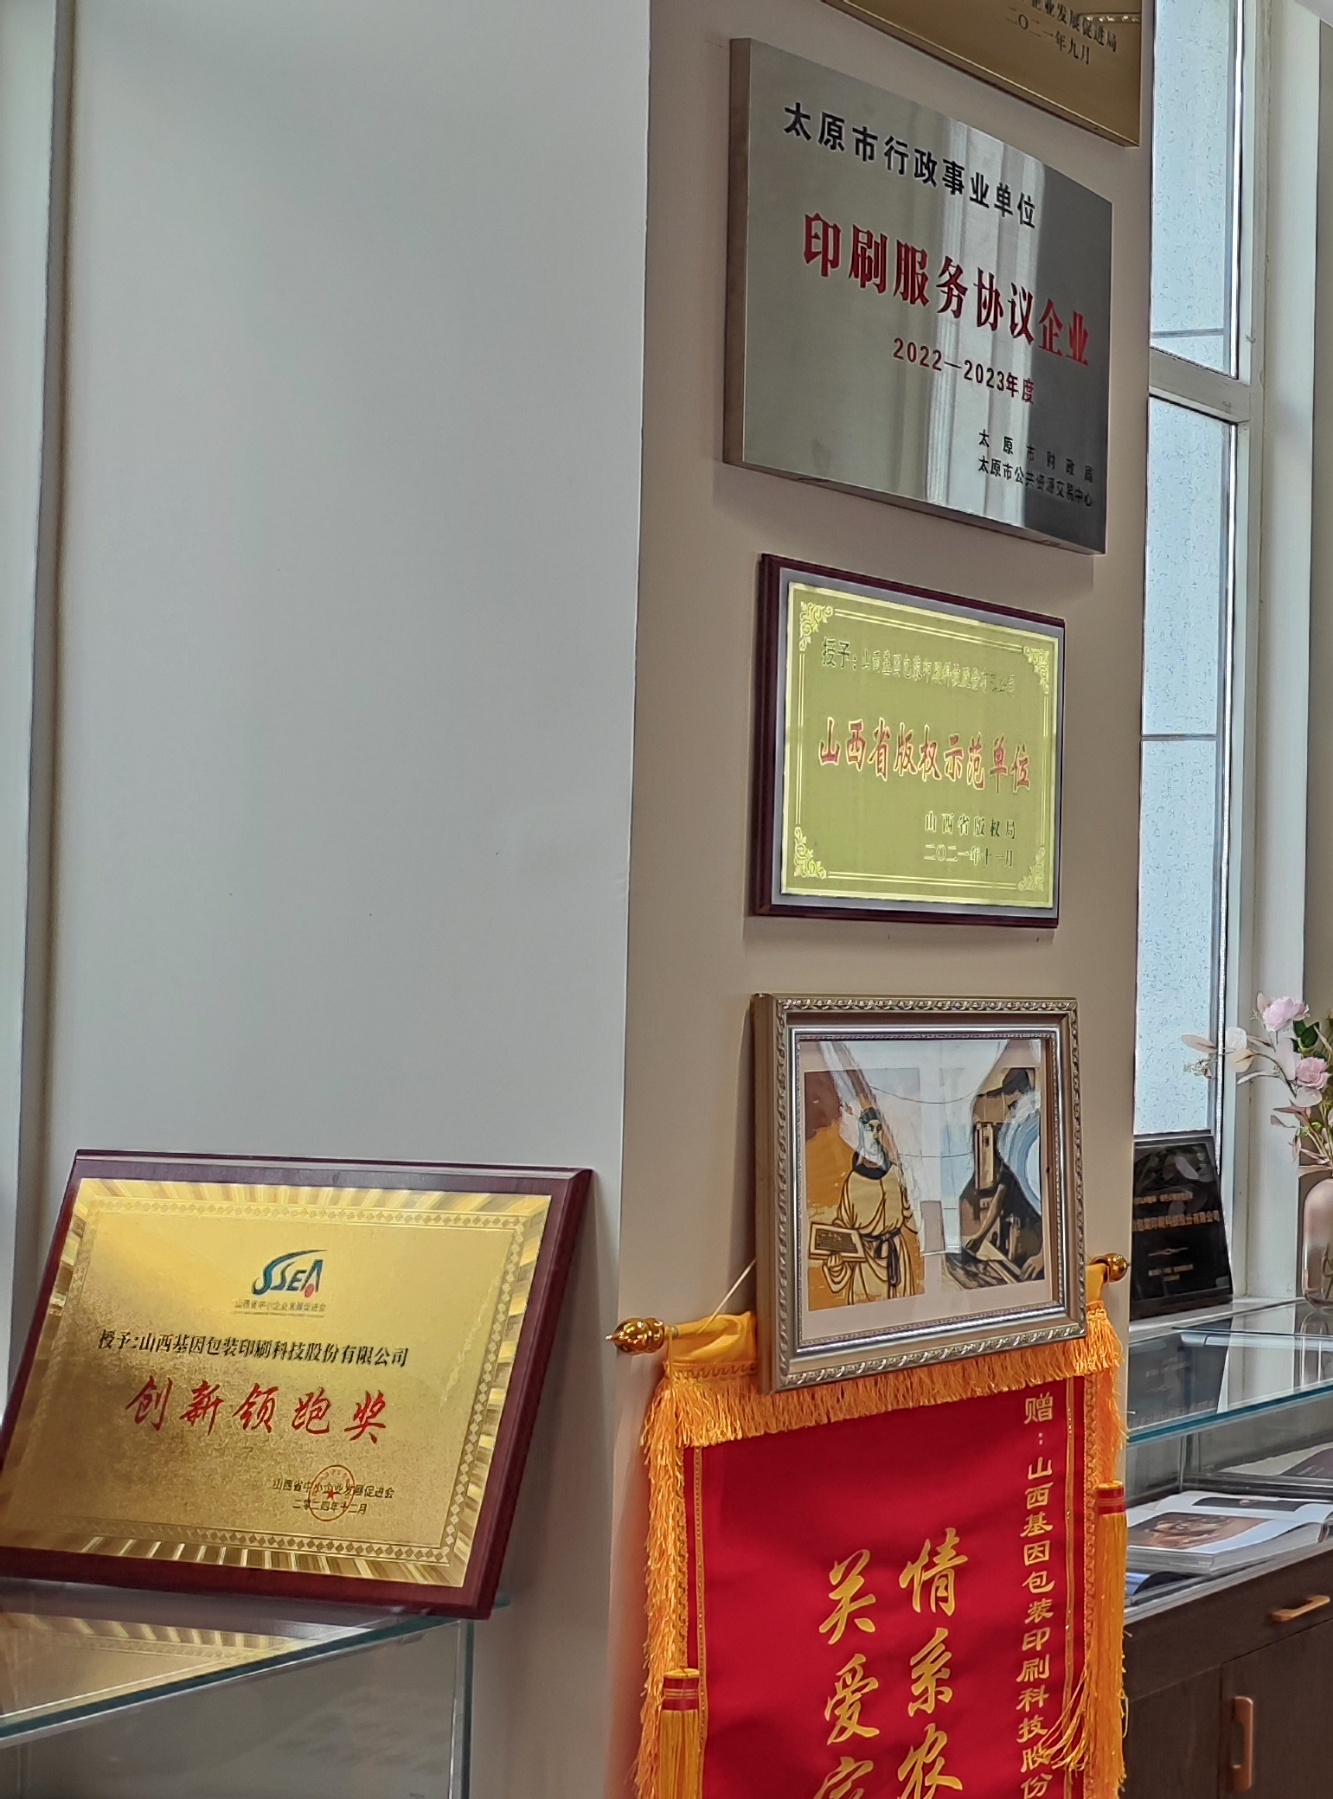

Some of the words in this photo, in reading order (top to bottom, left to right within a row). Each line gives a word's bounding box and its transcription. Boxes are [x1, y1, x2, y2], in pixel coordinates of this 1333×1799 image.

[783, 101, 1037, 230] 太原市行政事业单位
[802, 212, 1090, 367] 印刷服务协议企业
[978, 455, 1093, 507] 太原市公共资源交易中心
[818, 716, 1032, 794] 山西省版权示范单位
[924, 810, 1016, 840] 山西省版权局
[124, 1374, 388, 1445] 创新领跑奖
